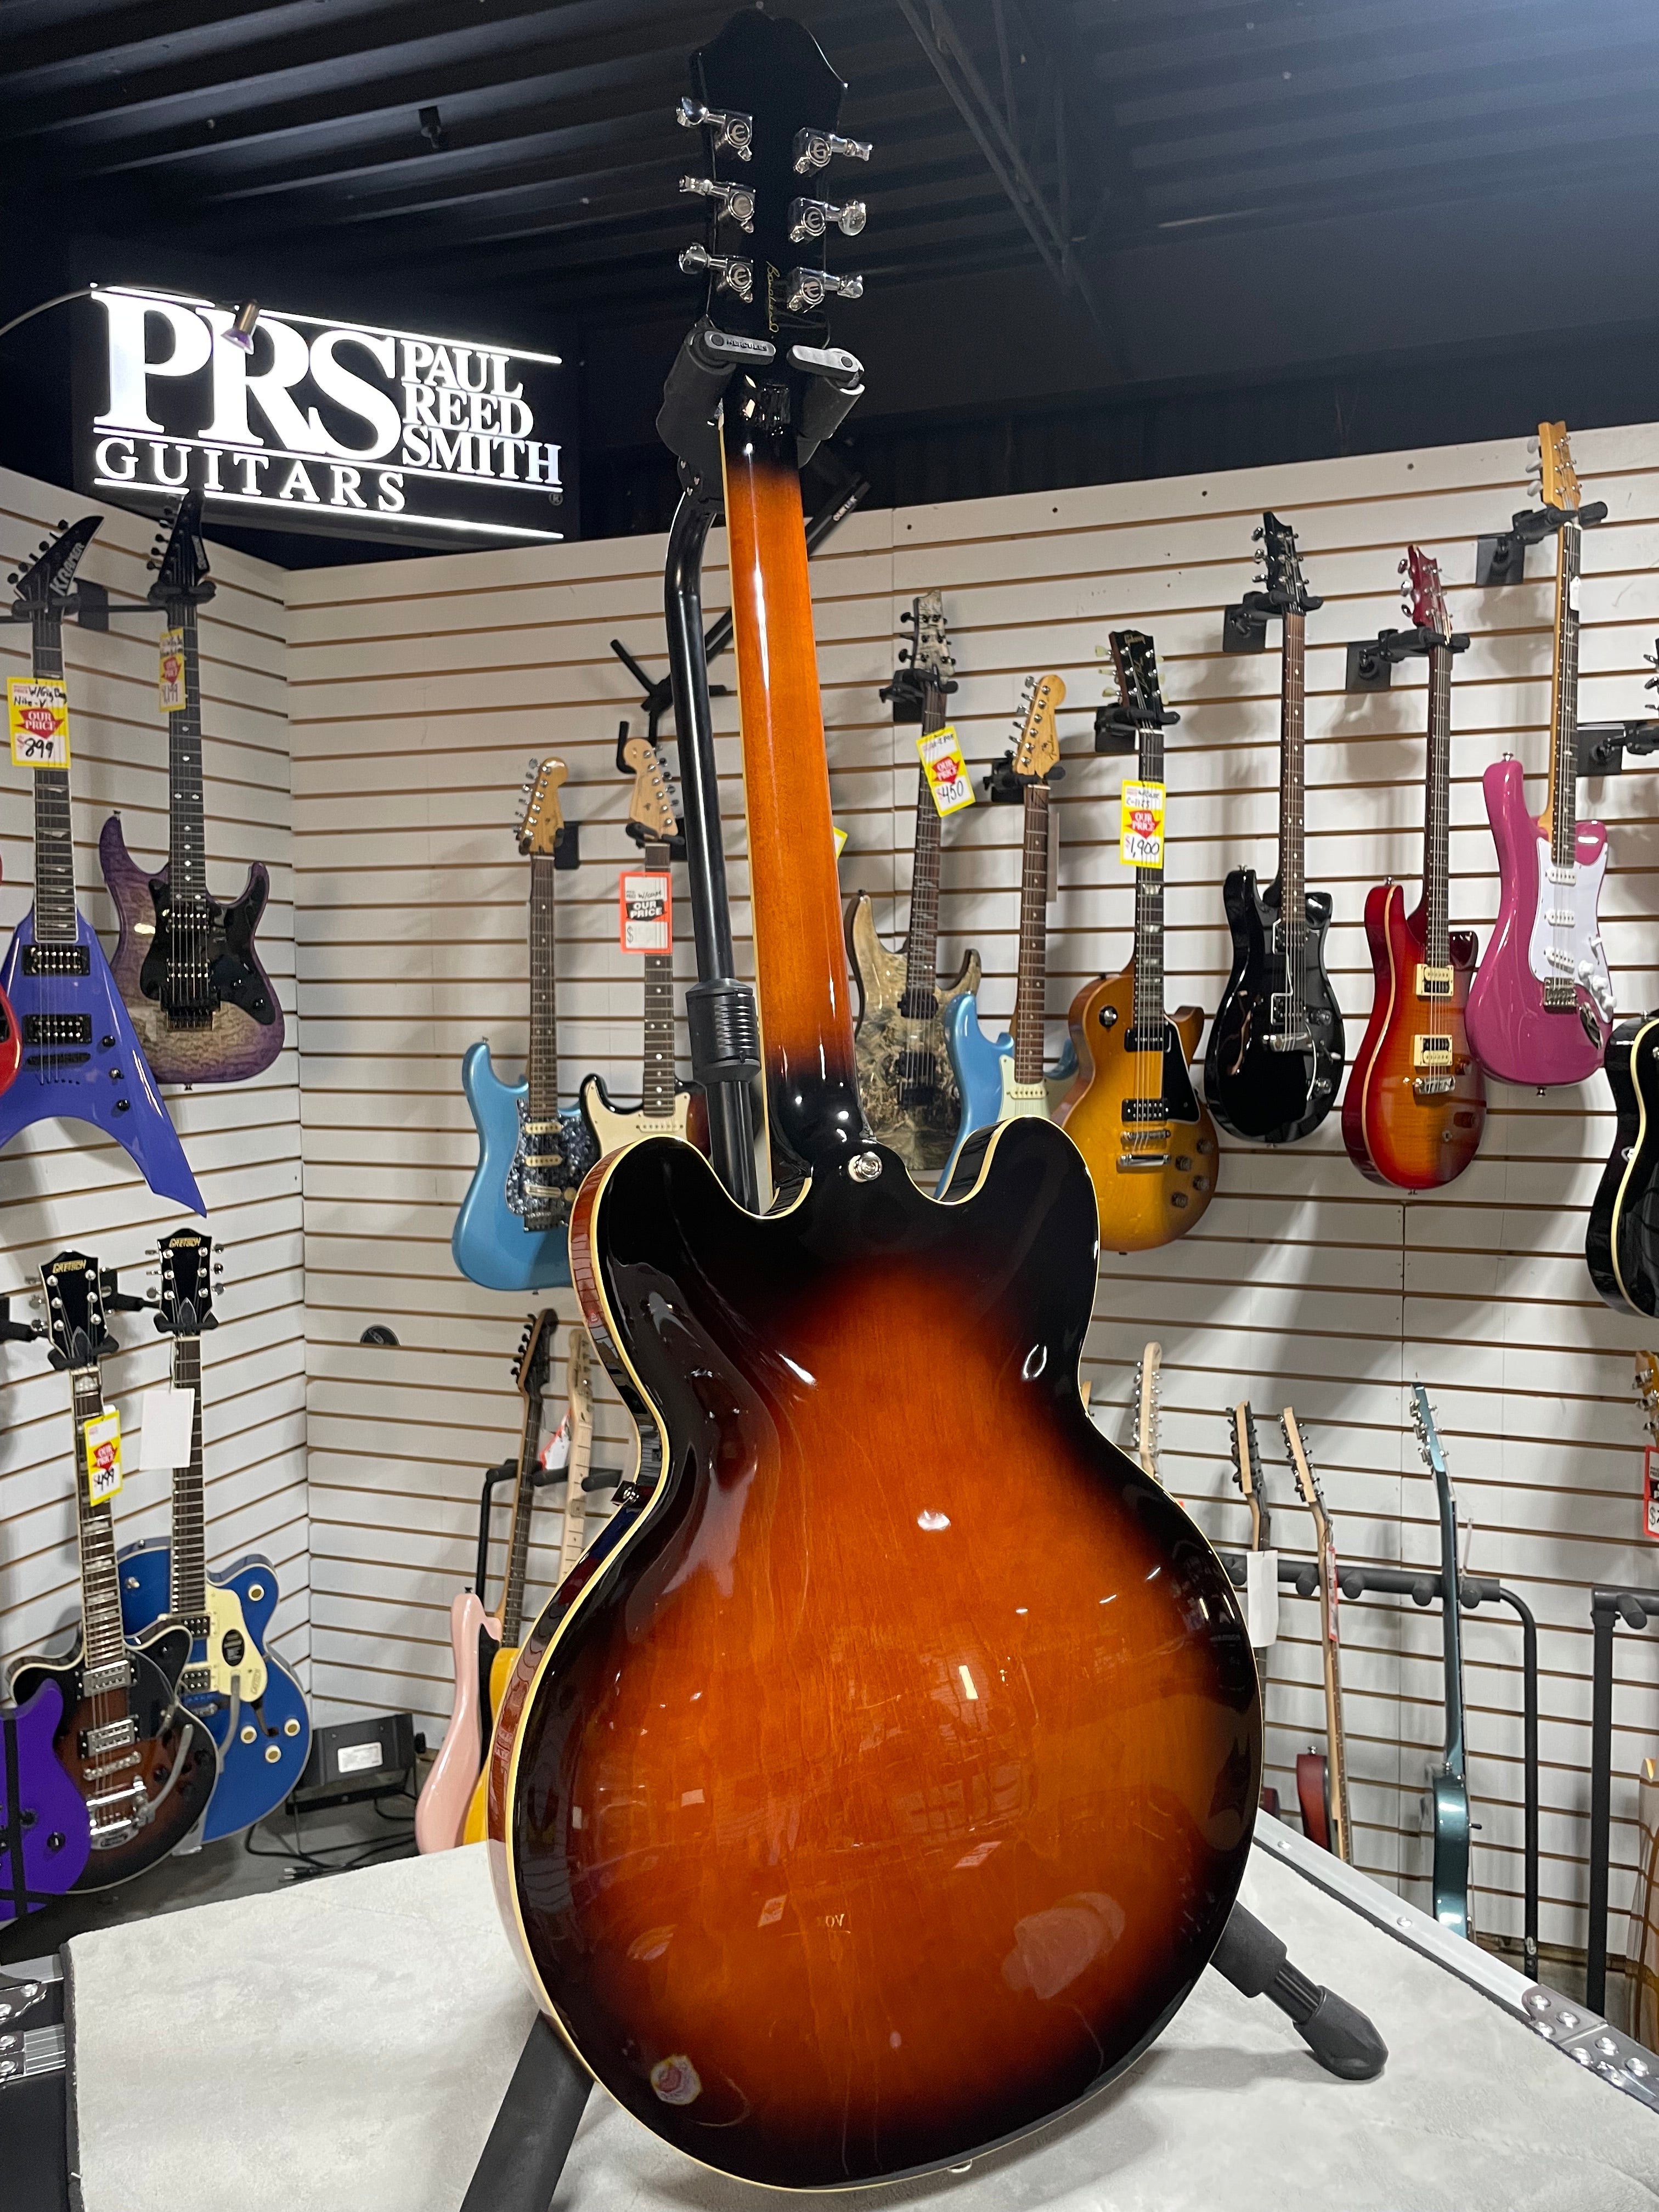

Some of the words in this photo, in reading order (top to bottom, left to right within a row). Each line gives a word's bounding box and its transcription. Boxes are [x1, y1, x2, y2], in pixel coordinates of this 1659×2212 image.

[91, 291, 401, 461] PRS
[400, 338, 523, 398] PAUL
[400, 382, 533, 439] REED
[95, 437, 405, 512] GUITARS
[401, 424, 562, 484] SMITH
[49, 542, 85, 596] KRAMER
[28, 710, 52, 721] OUR
[1135, 812, 1153, 822] OUR
[630, 907, 663, 919] PRICE
[633, 901, 657, 910] OUR
